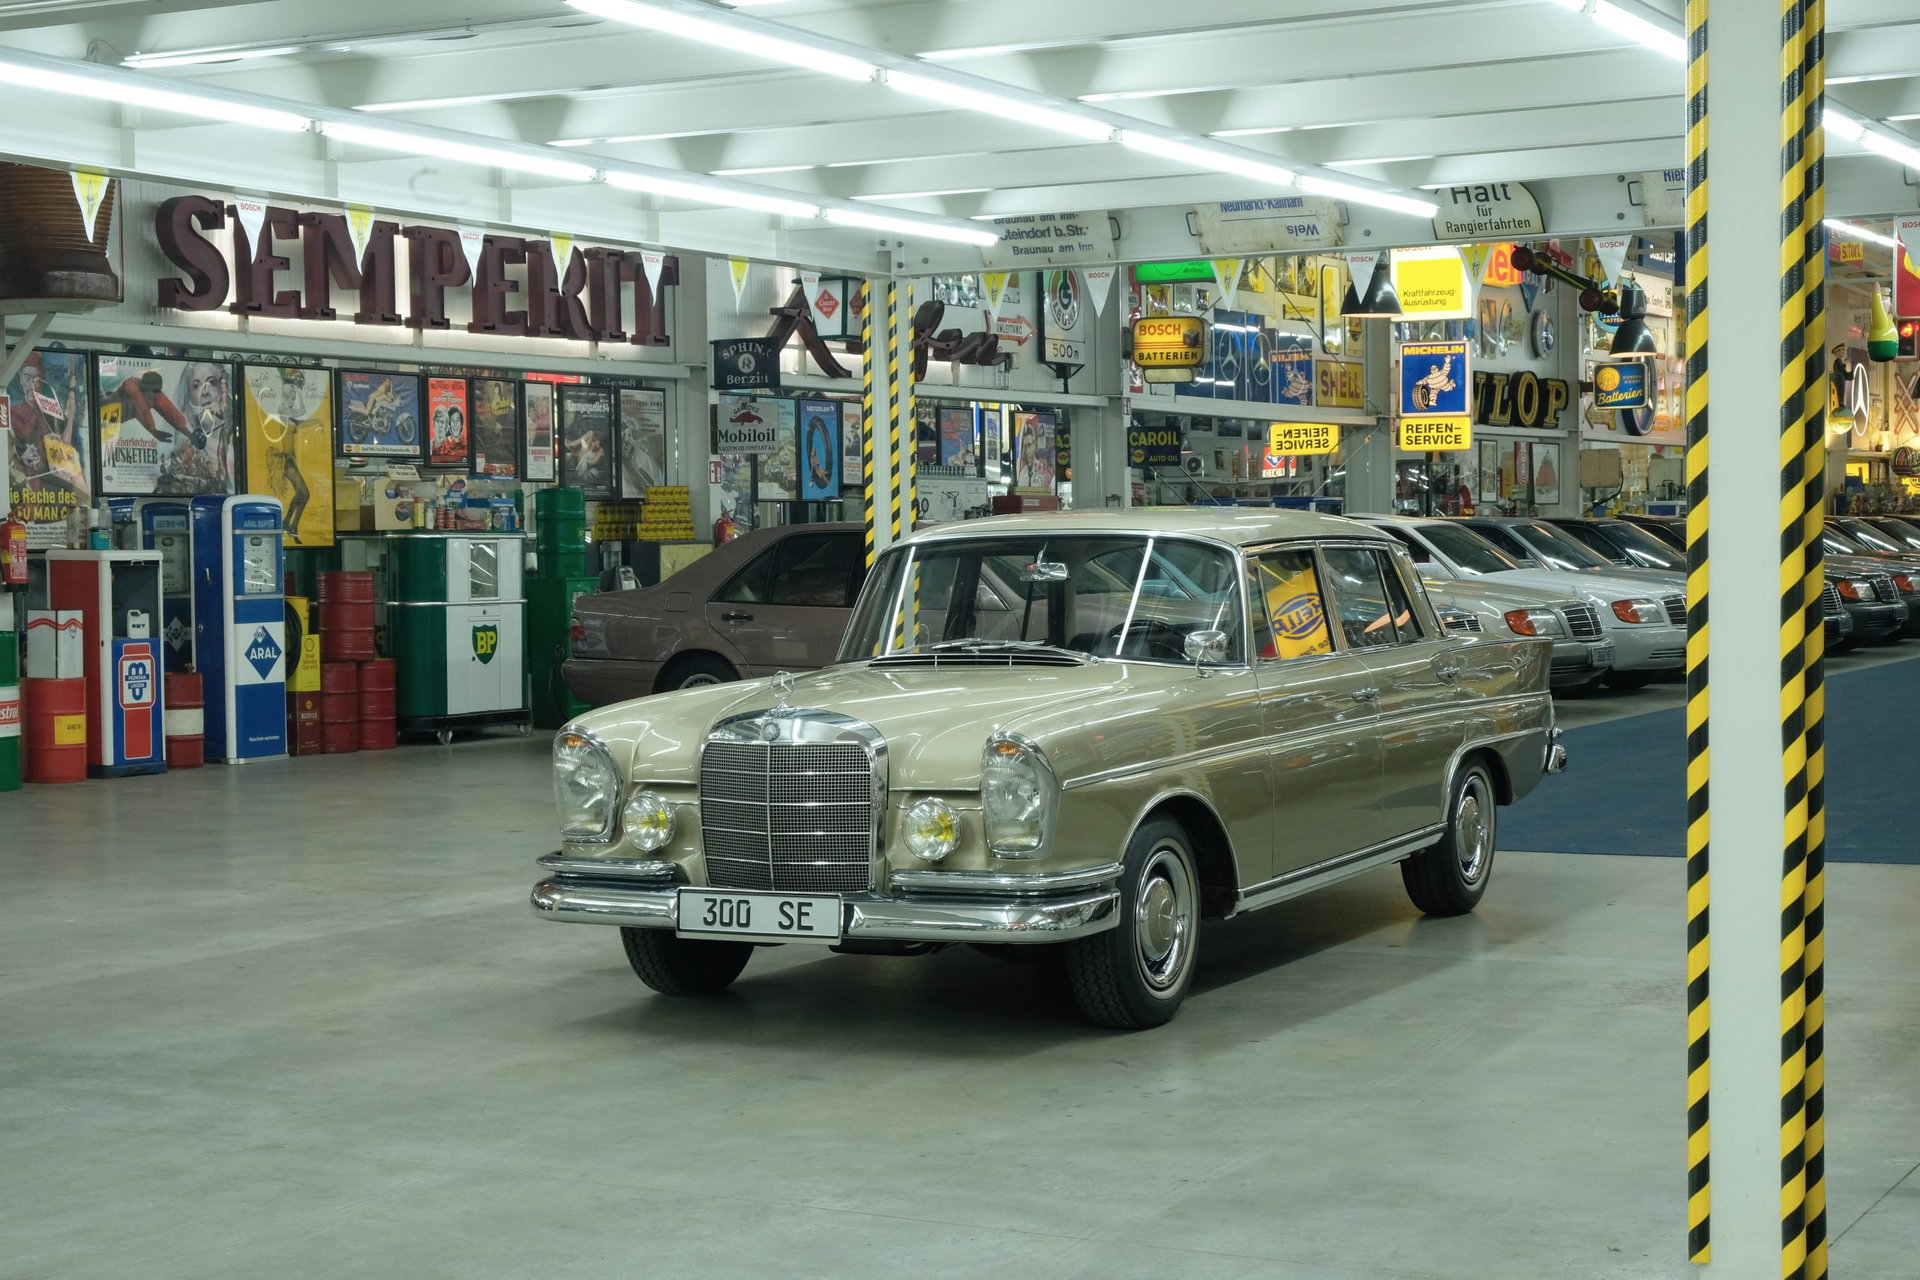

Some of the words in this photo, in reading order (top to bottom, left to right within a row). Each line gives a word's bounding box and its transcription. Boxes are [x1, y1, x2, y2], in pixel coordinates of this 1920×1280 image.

[1450, 183, 1511, 204] Halt
[240, 202, 262, 213] BOSCH
[1477, 205, 1493, 217] für
[1287, 224, 1320, 237] Wels
[1446, 218, 1531, 235] Rangierfahrten
[462, 232, 480, 241] BOSCH
[1012, 245, 1054, 255] Braunau
[1059, 245, 1074, 253] am
[1078, 242, 1094, 251] Inn
[1600, 241, 1624, 249] BOSCH
[644, 255, 660, 265] BOSCH
[155, 195, 679, 347] SEMPERIT
[1403, 289, 1456, 298] Kraftfahrzeug-
[1403, 298, 1446, 307] Ausrüstung
[1139, 324, 1181, 336] BOSCH
[1052, 343, 1073, 358] 500
[1138, 351, 1198, 361] BATTERIEN
[1403, 345, 1464, 355] MICHELIN
[1320, 369, 1360, 399] SHELL
[1598, 387, 1643, 405] Batterien
[1406, 423, 1462, 434] REIFEN-
[718, 428, 775, 443] Mobiloil
[1129, 431, 1179, 447] CAROIL
[1405, 434, 1462, 445] SERVICE
[10, 486, 20, 504] ie
[22, 487, 56, 504] Rache
[58, 487, 77, 504] des
[34, 506, 59, 520] MAN
[476, 631, 497, 654] BP
[249, 647, 278, 660] ARAL
[0, 703, 19, 720] strol
[703, 897, 751, 927] 300
[778, 900, 814, 931] SE
